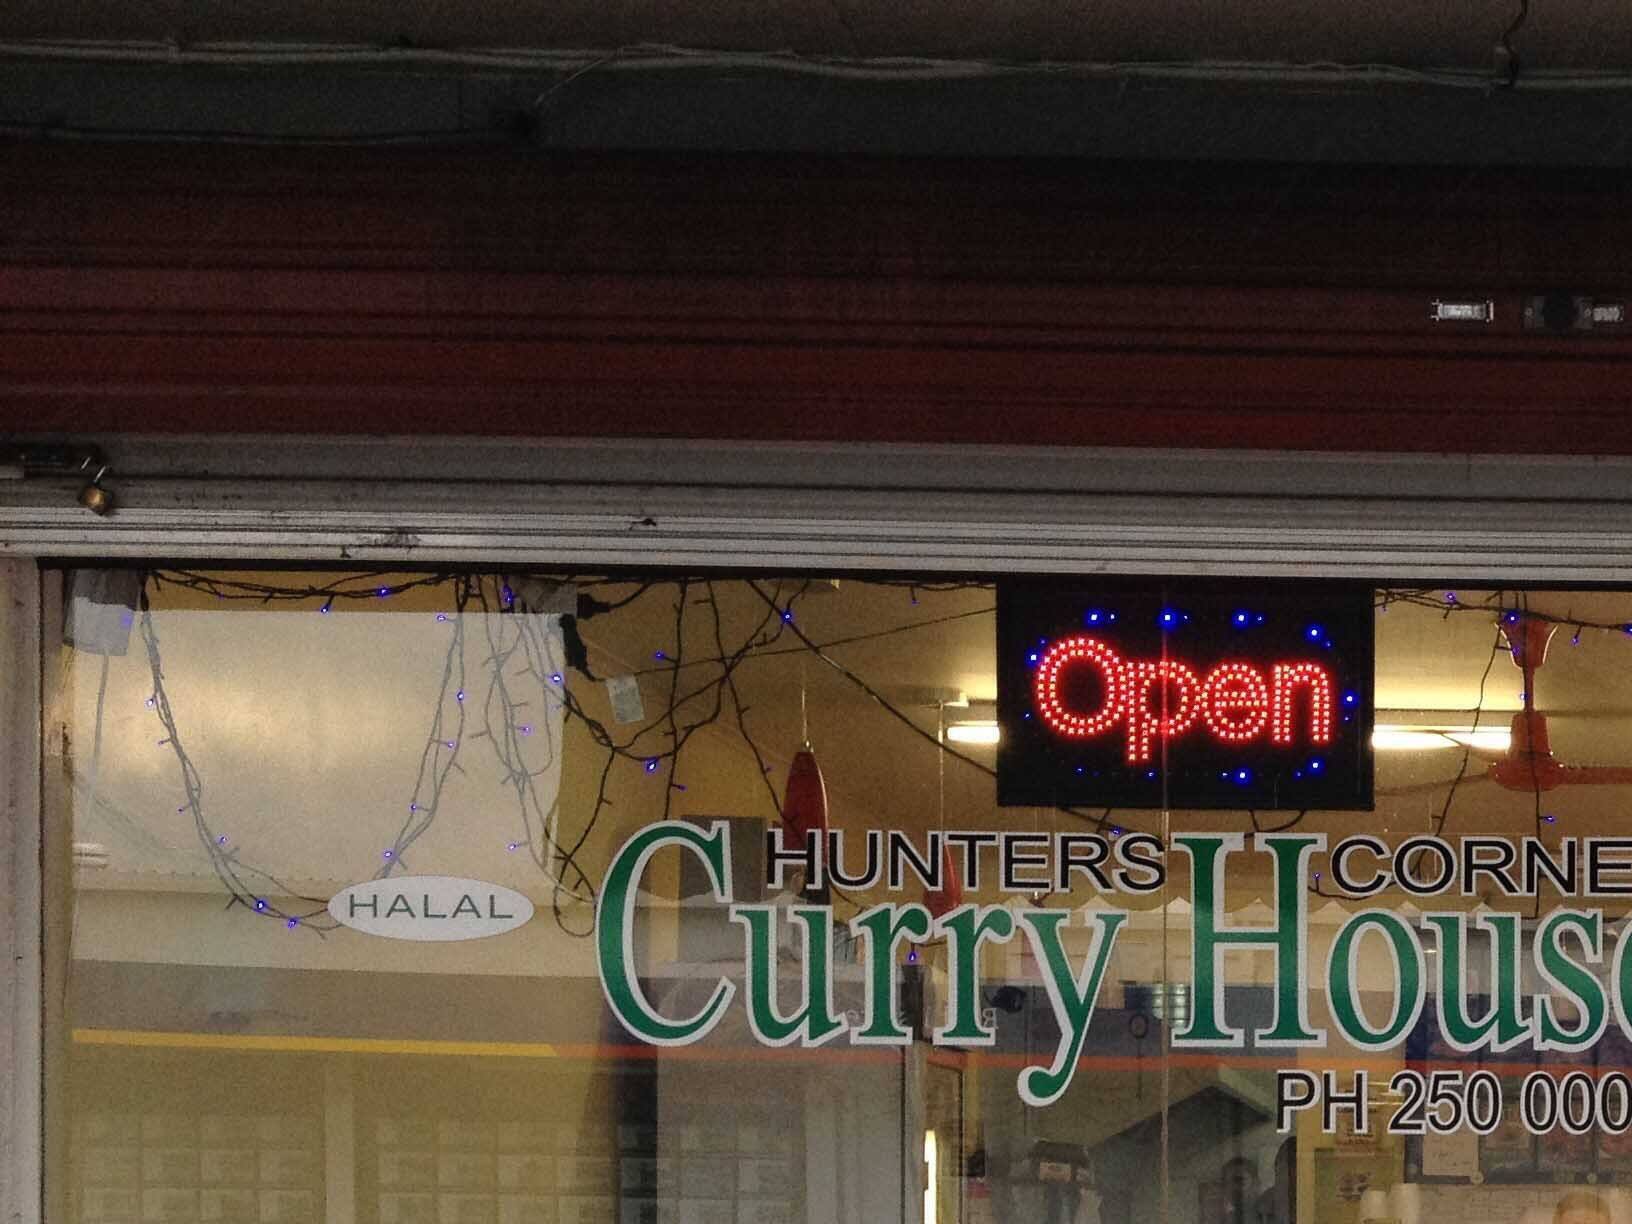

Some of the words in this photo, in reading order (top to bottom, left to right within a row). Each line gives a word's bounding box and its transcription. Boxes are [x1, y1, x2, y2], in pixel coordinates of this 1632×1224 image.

[1036, 636, 1332, 763] Open
[767, 829, 1167, 894] HUNTERS
[349, 894, 513, 918] HALAL
[597, 820, 1129, 1106] Curry
[1276, 1069, 1368, 1133] PH
[1388, 1069, 1502, 1134] 250
